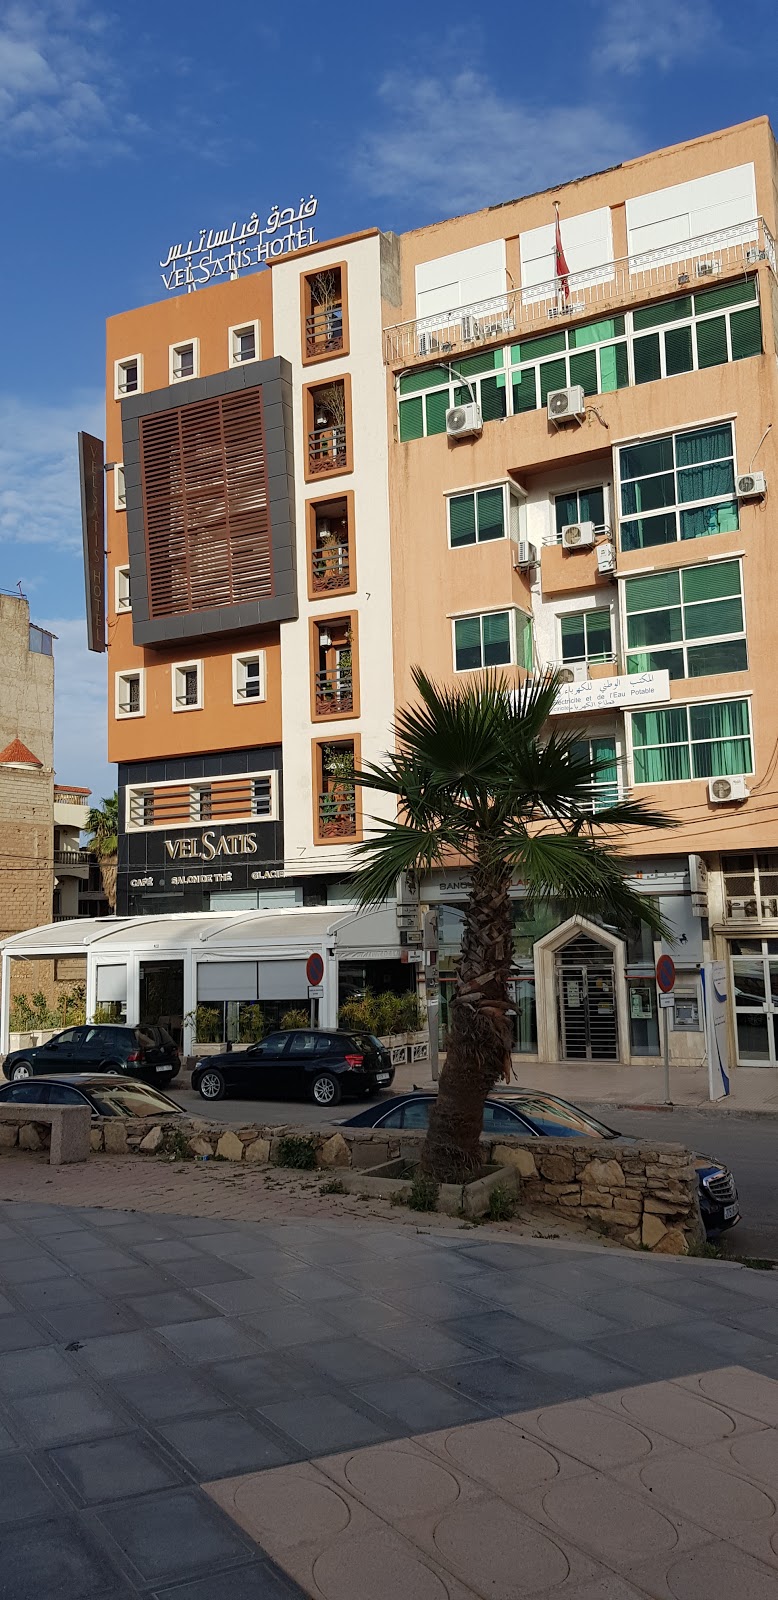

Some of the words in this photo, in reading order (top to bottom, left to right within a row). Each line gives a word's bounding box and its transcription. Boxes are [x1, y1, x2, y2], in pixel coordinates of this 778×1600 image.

[265, 194, 318, 234] فندق
[160, 266, 196, 291] VEL
[199, 247, 252, 284] SATIS
[257, 226, 319, 262] HOTEL
[92, 569, 102, 642] HOTEL
[596, 693, 605, 701] de
[630, 687, 655, 697] Potable
[130, 876, 154, 887] CAFÉ
[171, 875, 200, 885] SALON
[213, 871, 233, 882] THÉ
